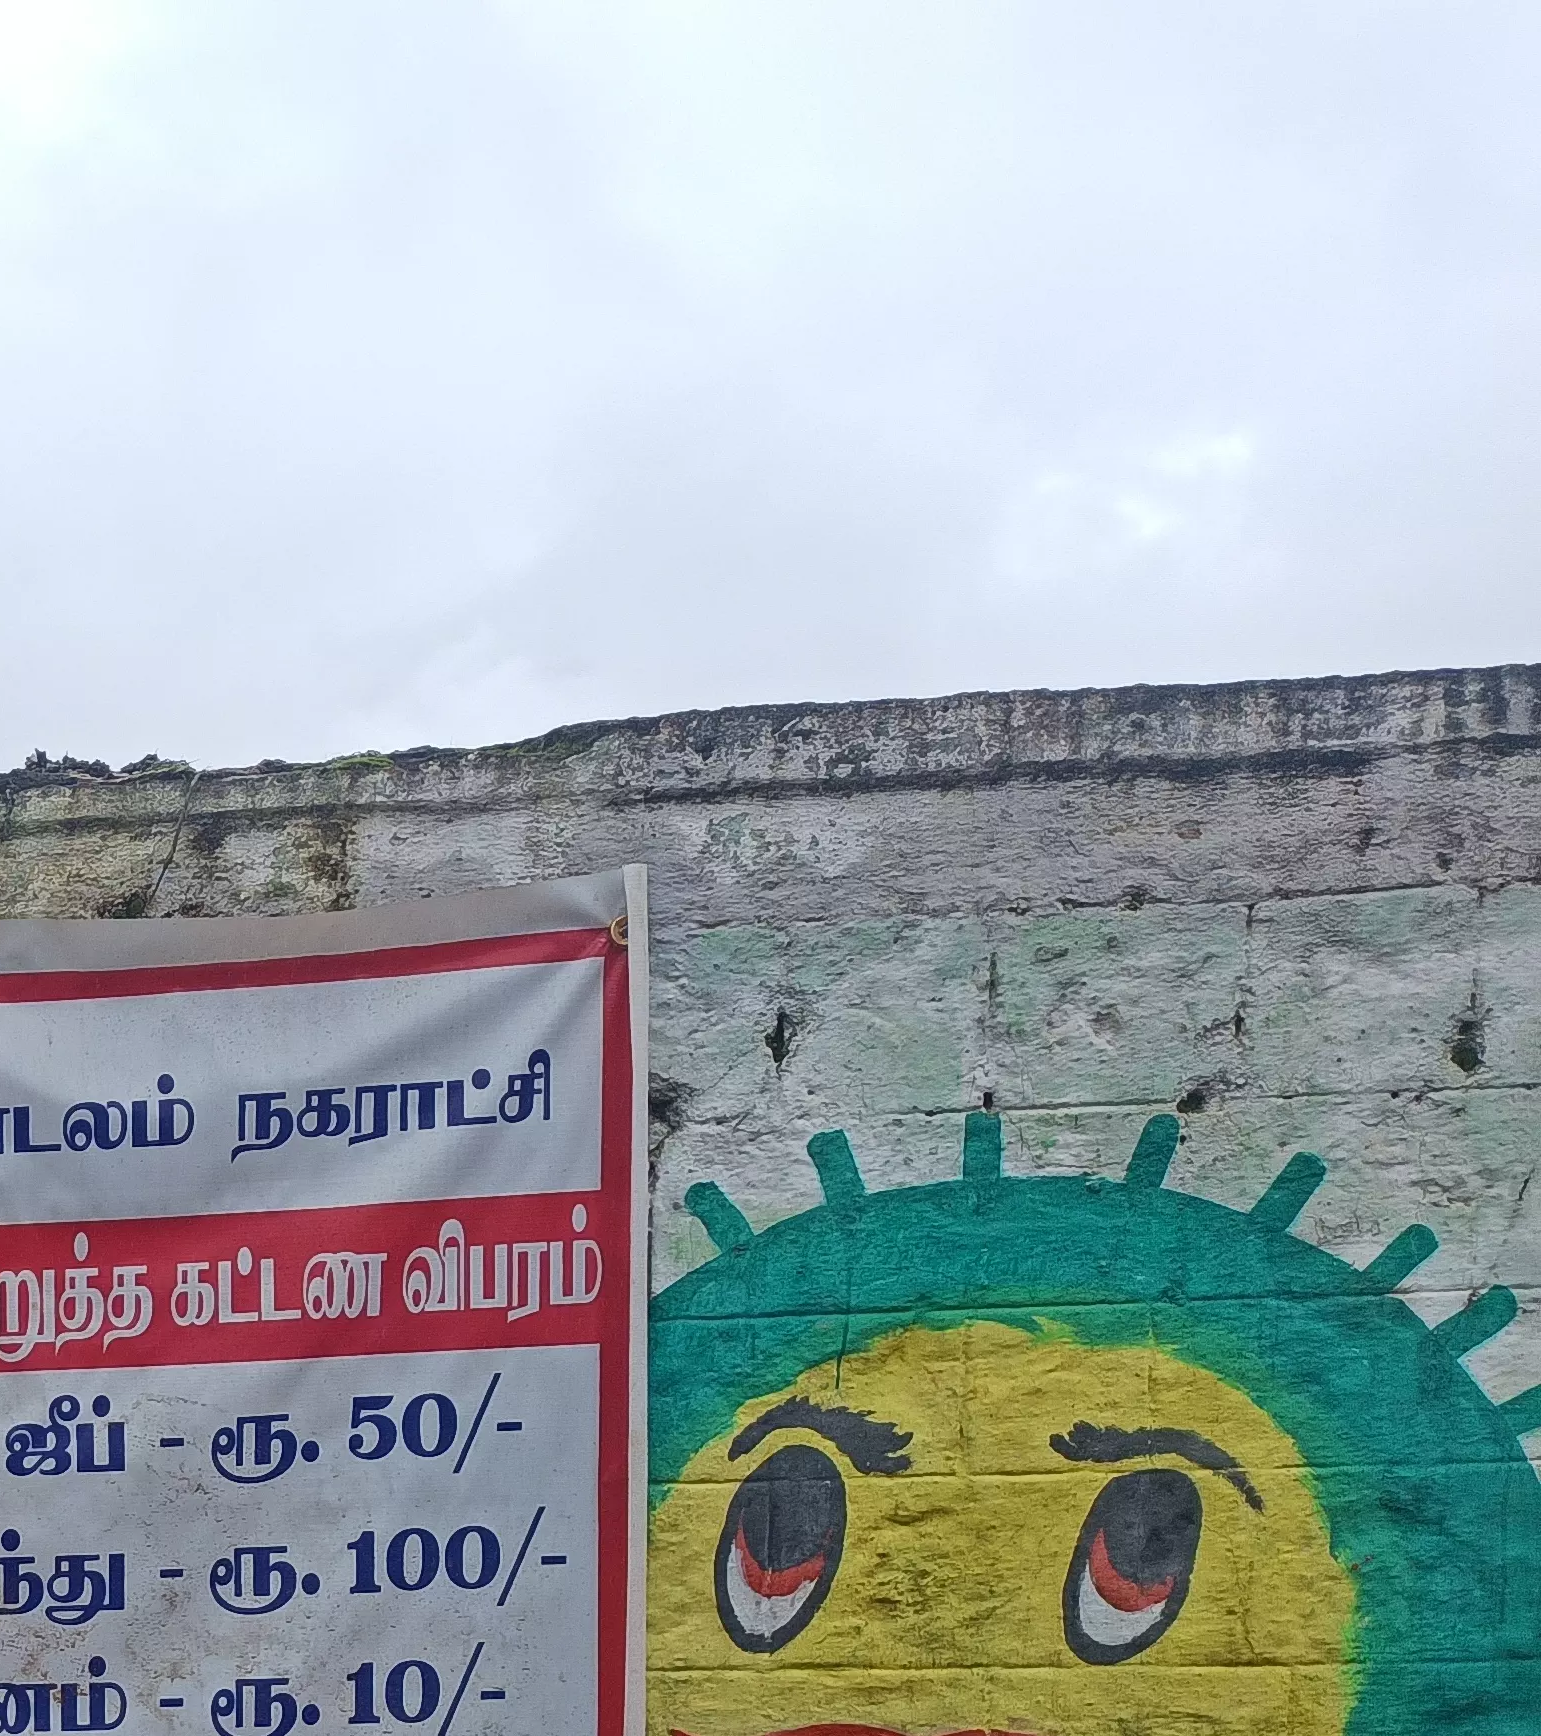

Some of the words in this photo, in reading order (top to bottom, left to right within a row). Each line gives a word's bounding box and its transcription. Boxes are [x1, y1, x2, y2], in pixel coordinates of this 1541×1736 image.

[230, 1048, 551, 1164] நகராட்சி
[170, 1246, 388, 1327] கட்டண
[402, 1203, 602, 1323] விபரம்
[4, 1394, 126, 1477] ஜீப்
[159, 1437, 185, 1449] -
[210, 1413, 320, 1485] ரூ.
[348, 1372, 523, 1475] 50/-
[159, 1568, 185, 1580] -
[209, 1545, 321, 1616] ரூ.
[346, 1505, 568, 1607] 100/-
[159, 1697, 184, 1708] -
